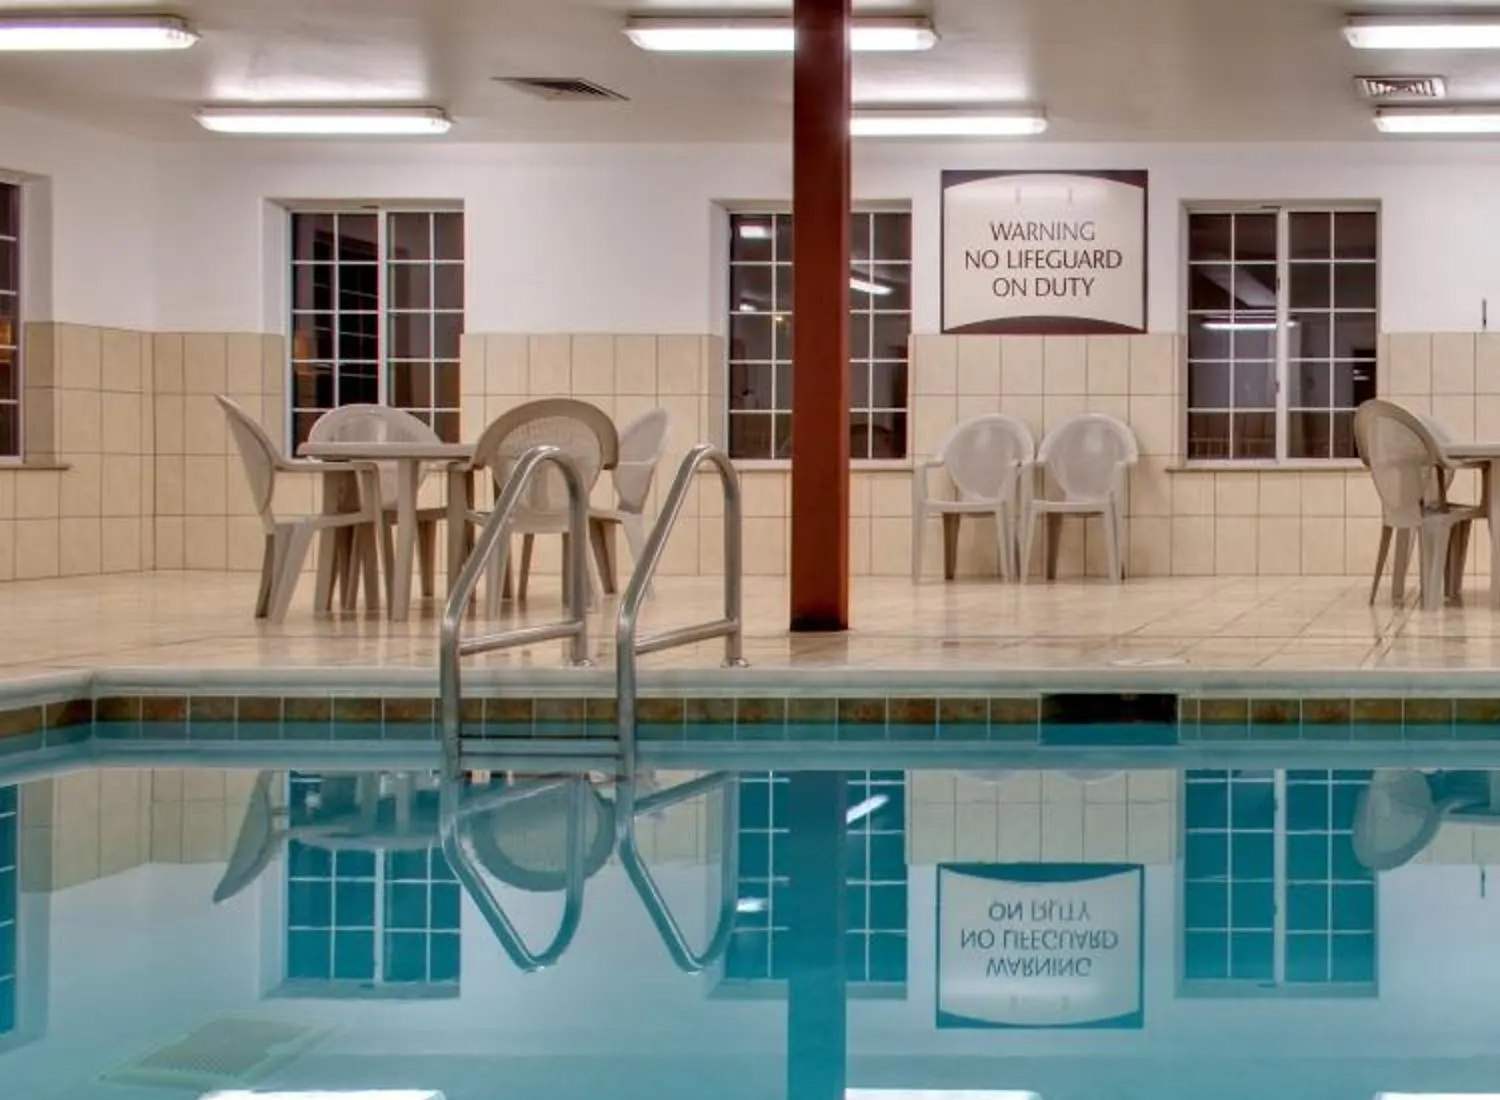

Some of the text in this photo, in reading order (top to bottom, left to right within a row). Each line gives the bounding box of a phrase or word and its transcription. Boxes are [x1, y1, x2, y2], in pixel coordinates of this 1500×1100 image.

[990, 220, 1096, 241] WARNING
[964, 249, 1123, 270] NO LIFEGUARD
[991, 277, 1095, 297] ON DUTY
